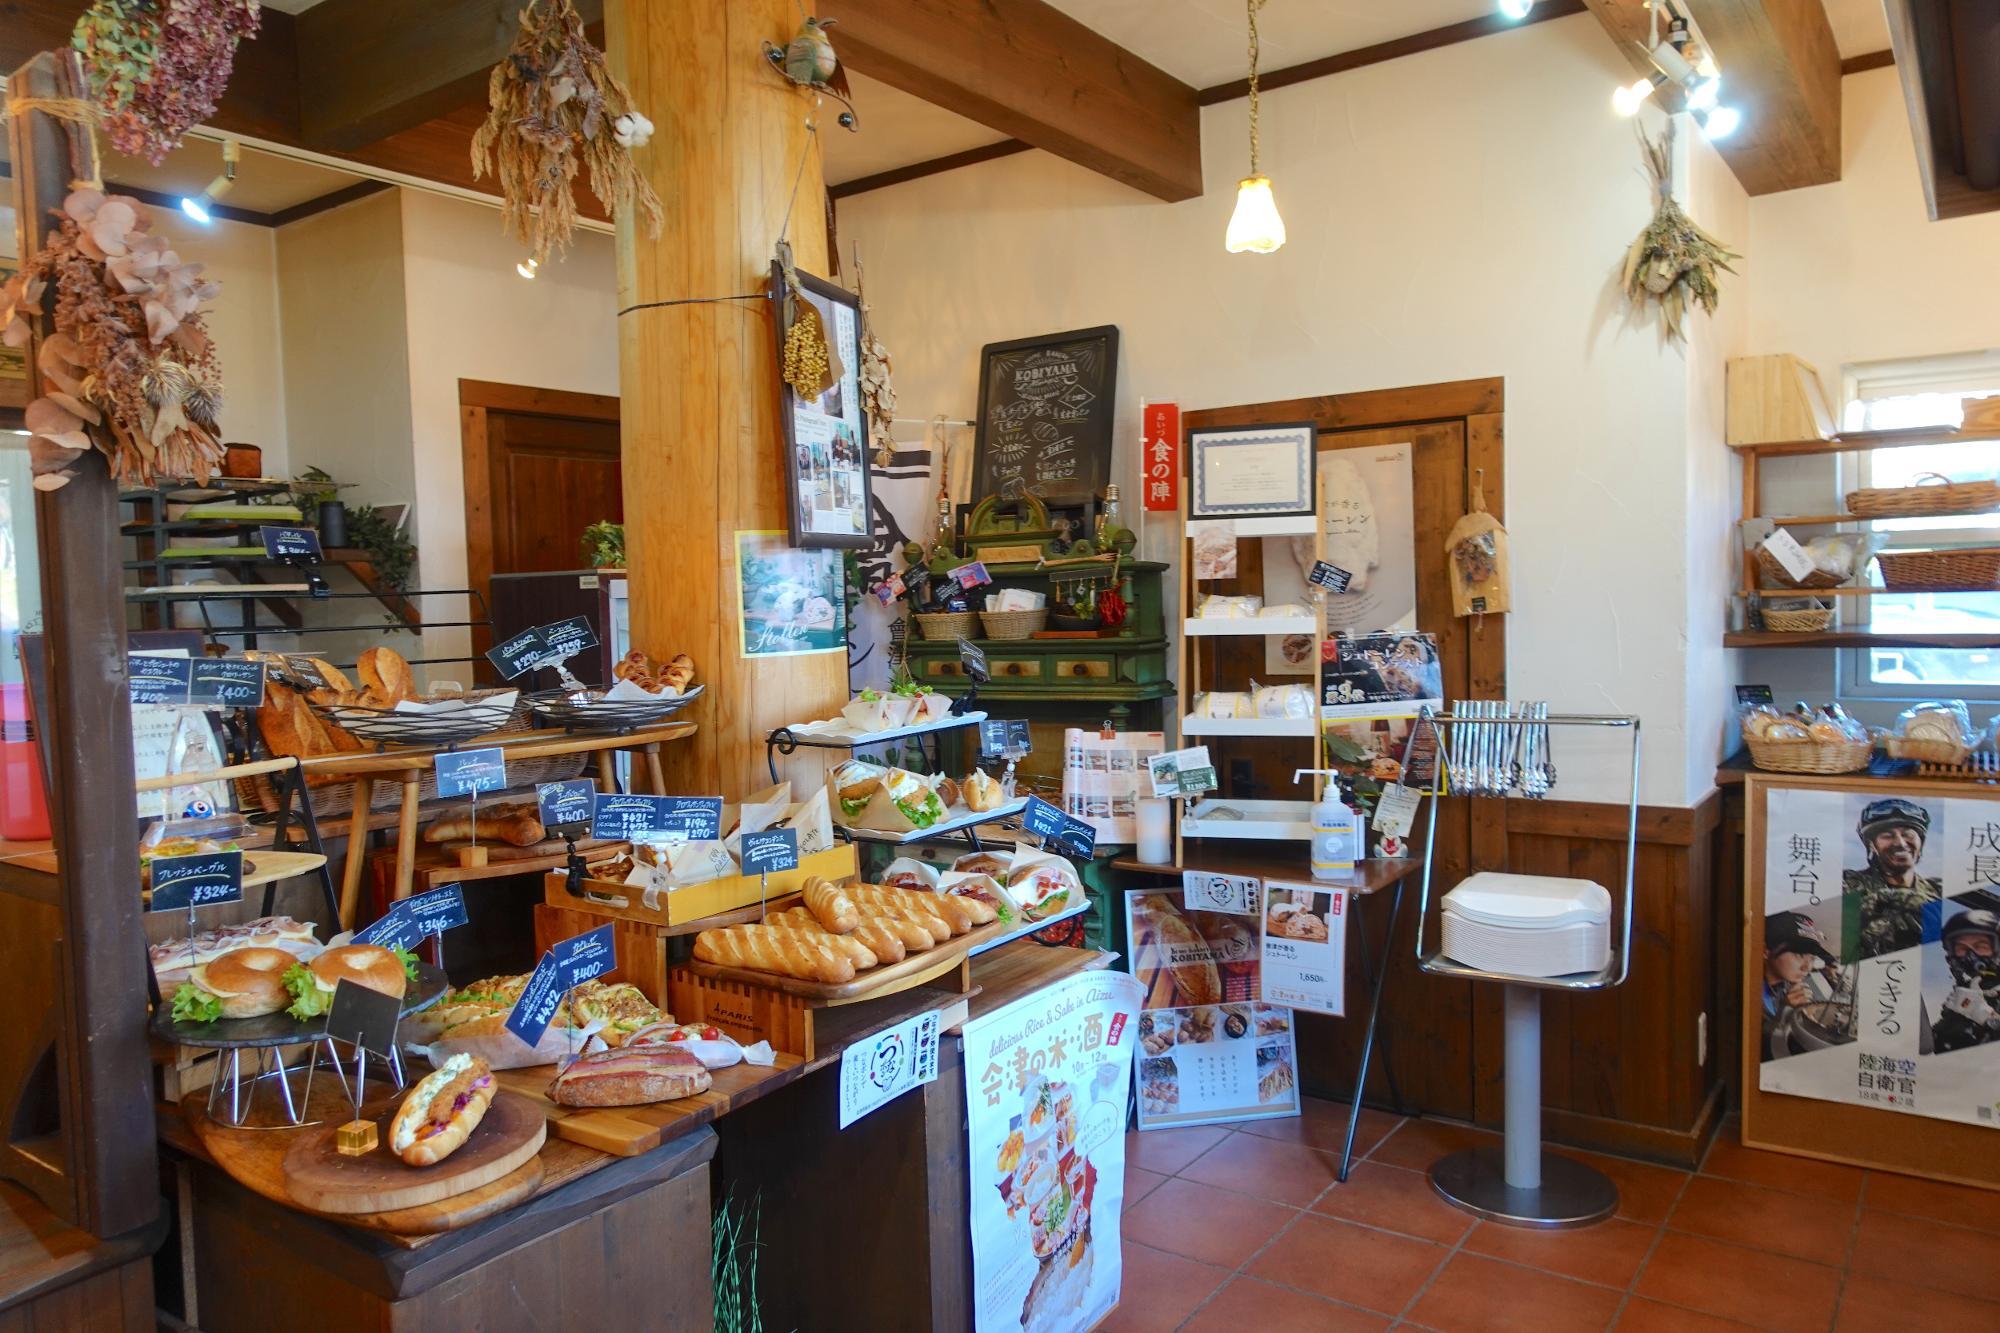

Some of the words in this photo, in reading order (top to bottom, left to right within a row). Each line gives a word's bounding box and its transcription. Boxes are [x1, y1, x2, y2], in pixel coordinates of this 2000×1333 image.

[1013, 363, 1076, 381] KOBIYAMA
[1157, 412, 1166, 437] あいづ
[1150, 438, 1174, 502] 食の陣
[512, 650, 543, 671] ¥270-
[216, 684, 256, 700] ¥400-
[556, 808, 590, 823] ¥400-
[622, 813, 653, 822] ¥421-
[771, 856, 797, 871] ¥324-
[1967, 822, 2000, 886] 成長
[159, 861, 227, 880] フレッシュベーグル
[1788, 833, 1822, 906] 舞台。
[193, 884, 237, 901] ¥324-
[1170, 952, 1225, 963] KOBIYAMA
[572, 961, 604, 984] ¥400-
[1875, 959, 1906, 1036] できる
[989, 1036, 1024, 1059] delicious
[1025, 1018, 1046, 1038] Rice
[1047, 1009, 1055, 1024] &
[1055, 998, 1075, 1020] Sake
[1076, 996, 1085, 1008] in
[1086, 988, 1115, 1004] Aizu
[1858, 1052, 1917, 1076] 陸海空
[1858, 1072, 1917, 1095] 自衛官
